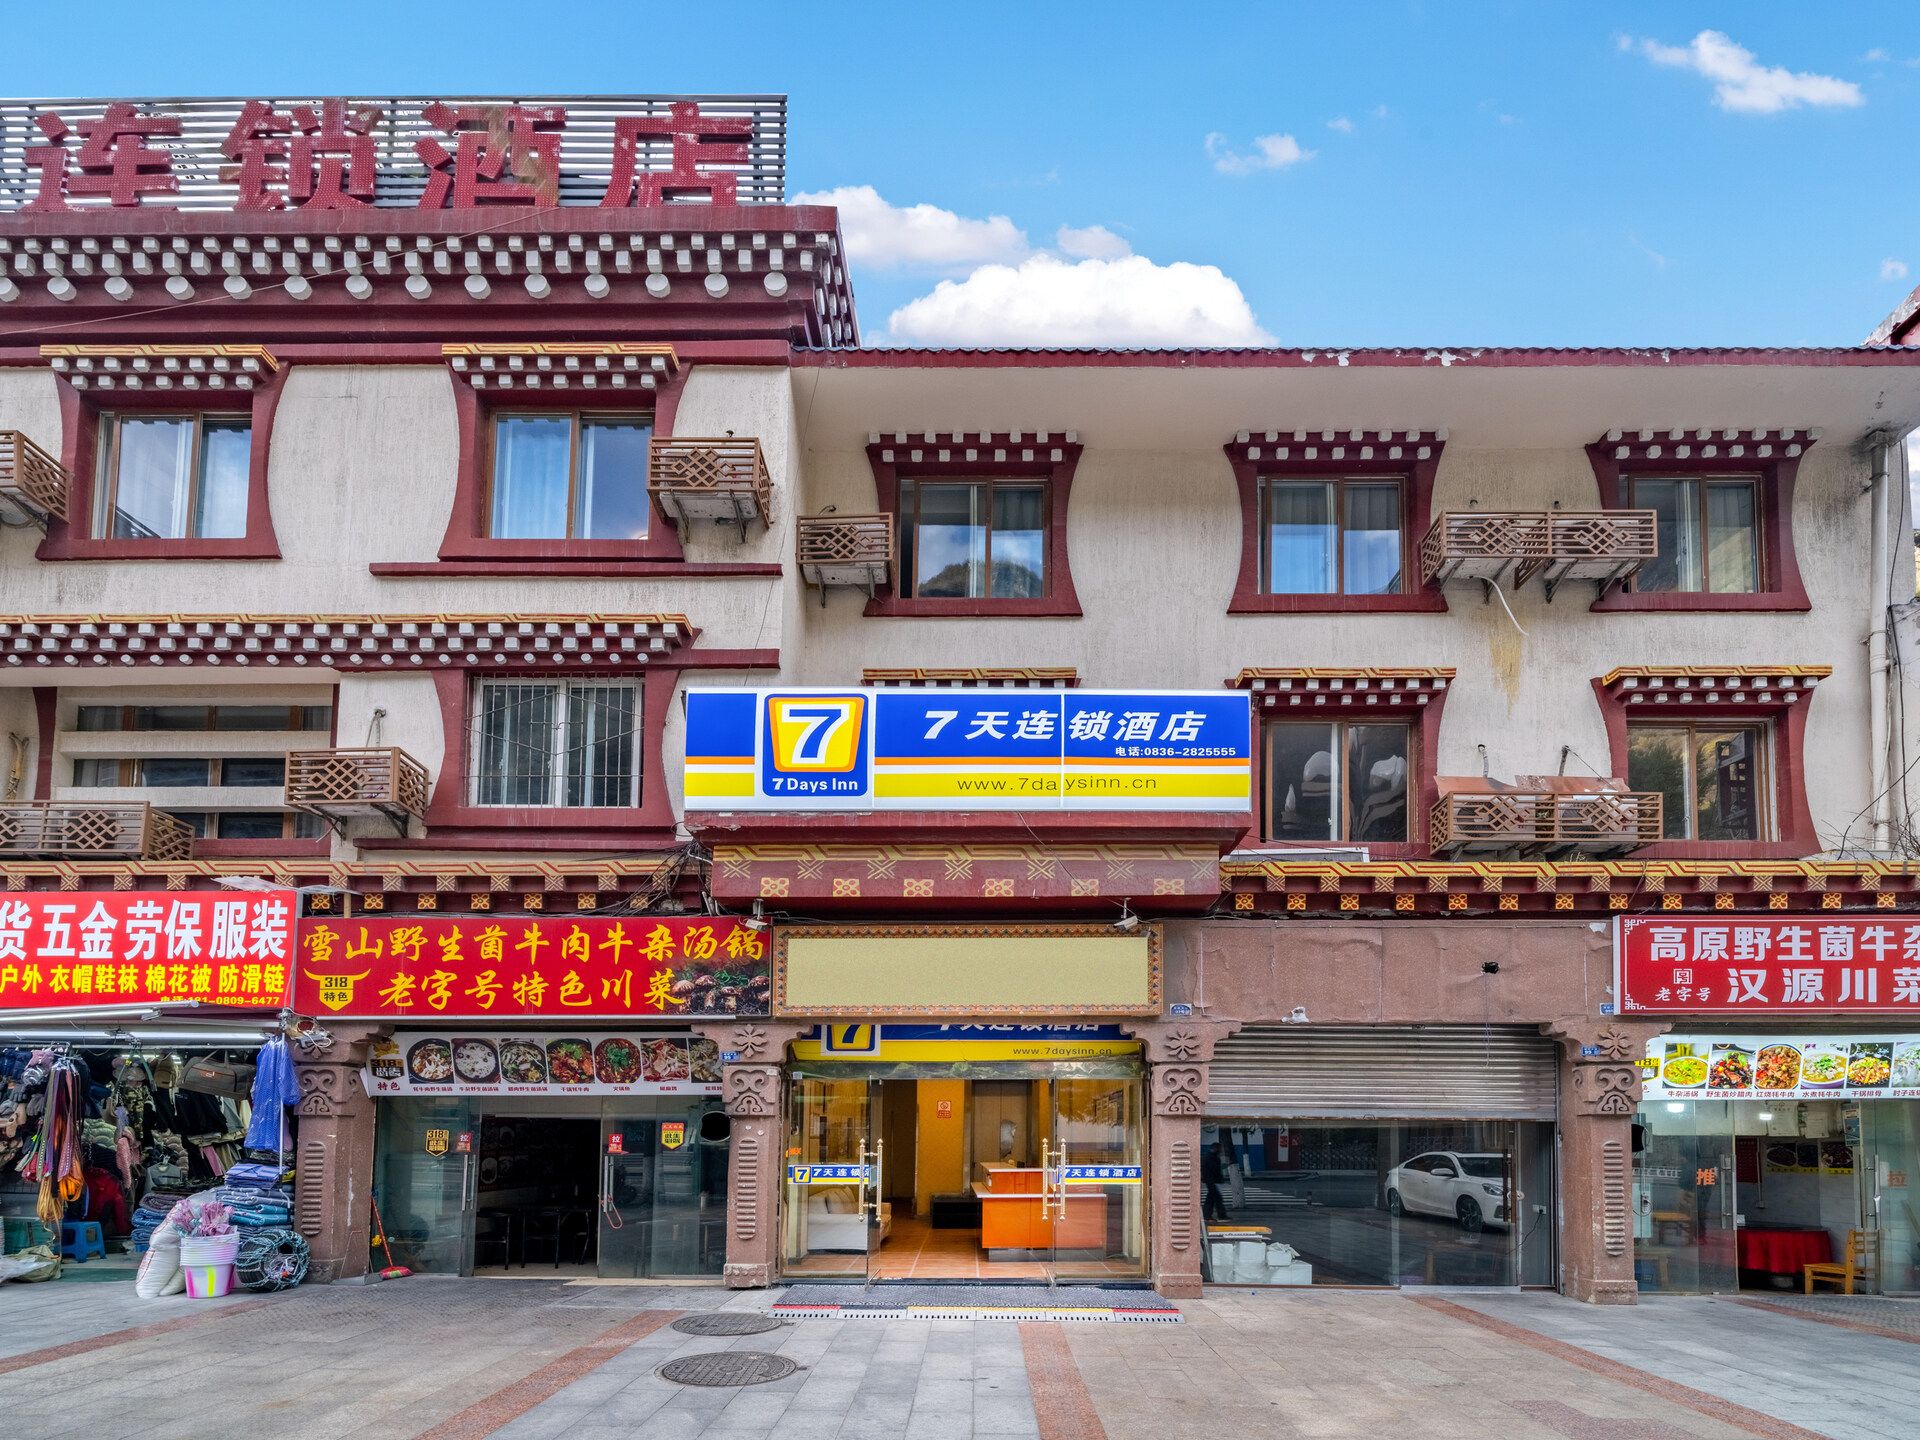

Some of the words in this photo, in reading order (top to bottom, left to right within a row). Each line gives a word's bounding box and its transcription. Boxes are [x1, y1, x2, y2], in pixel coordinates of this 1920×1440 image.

[21, 98, 752, 209] 连锁酒店
[922, 710, 1206, 742] 7天连锁酒店
[832, 777, 858, 790] Inn
[957, 777, 1157, 791] www.7daysinn.cn
[303, 922, 764, 966] 雪山野生菌牛肉牛杂汤锅
[324, 977, 348, 988] 318
[378, 967, 686, 1011] 老字号特色川菜
[324, 991, 349, 1002] 特色
[1655, 987, 1711, 1002] 老字号
[1012, 1047, 1112, 1056] www.7daysinn.cn
[377, 1081, 400, 1091] 特色
[1696, 1168, 1716, 1186] 推
[1888, 1171, 1907, 1188] 拉
